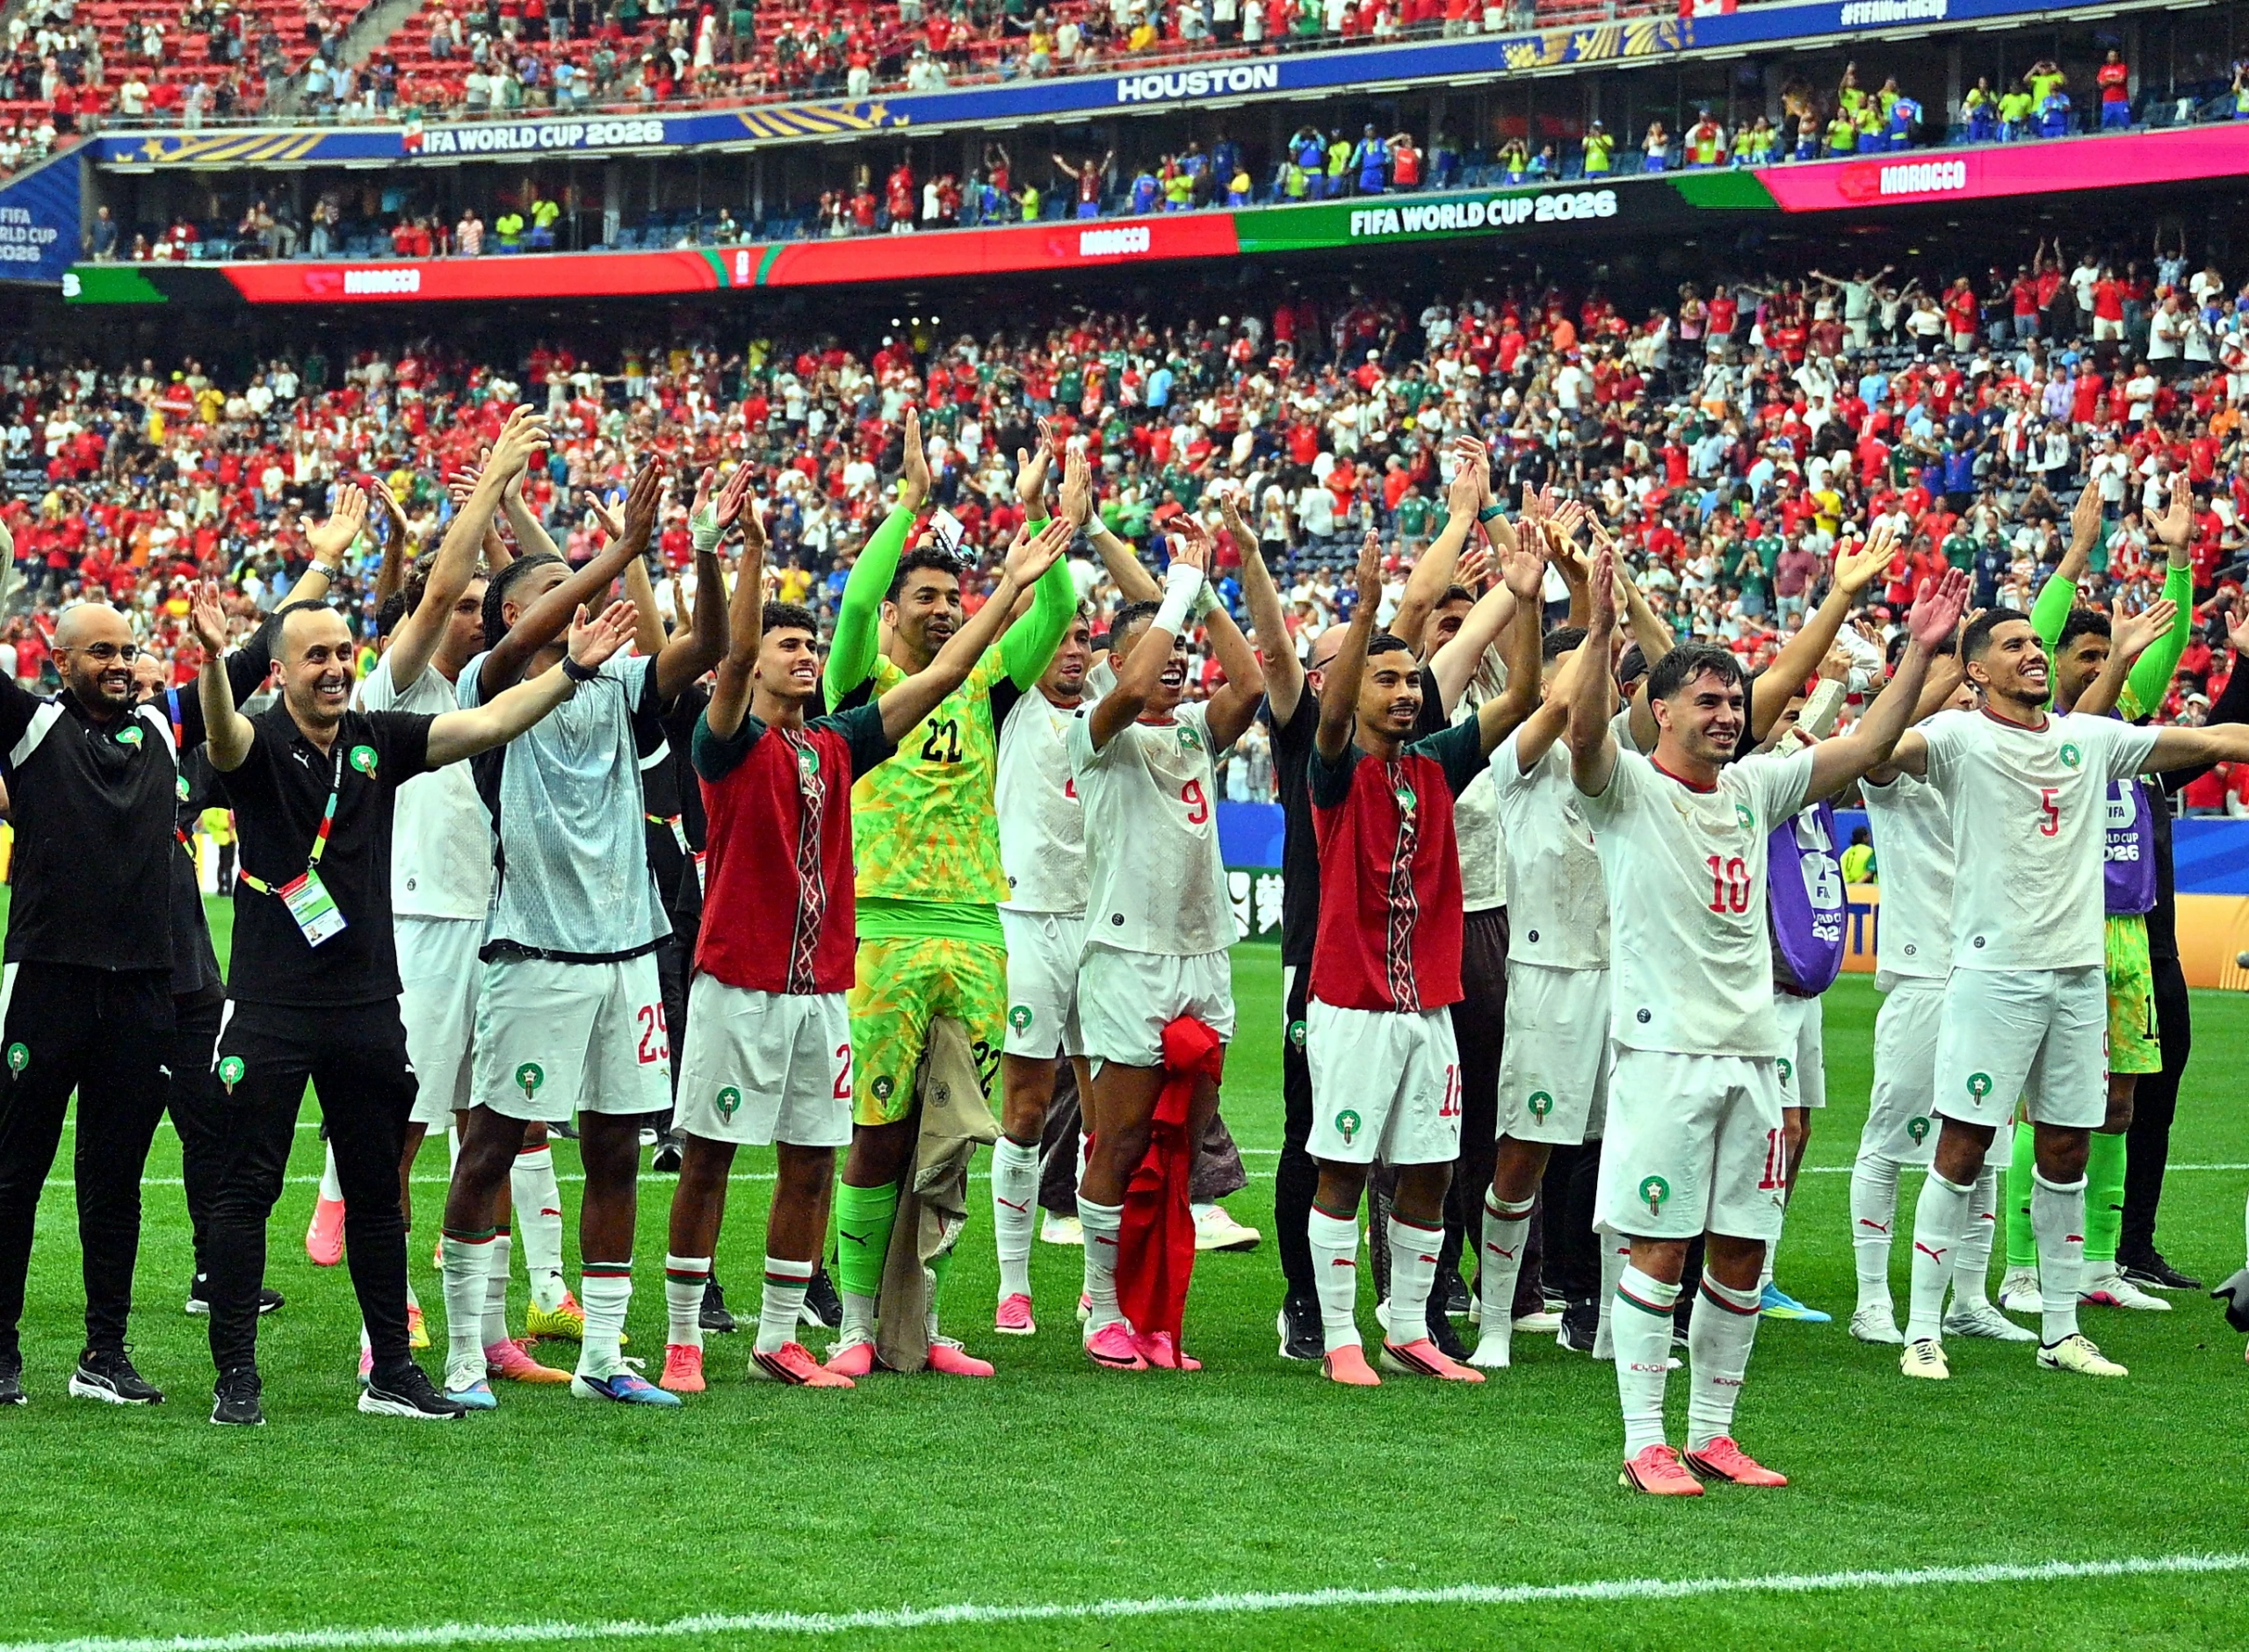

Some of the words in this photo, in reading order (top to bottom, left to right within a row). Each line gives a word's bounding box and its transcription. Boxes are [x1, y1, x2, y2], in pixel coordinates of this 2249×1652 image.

[1840, 0, 1948, 25] #FIFAWorldCup
[1117, 64, 1278, 102] HOUSTON
[410, 130, 456, 154] IFA
[458, 126, 537, 151] WORLD
[539, 125, 583, 148] CUP
[585, 120, 664, 145] 2026
[1880, 160, 1966, 195] MOROCCO
[0, 206, 32, 224] FIFA
[1350, 208, 1399, 236] FIFA
[1401, 201, 1485, 232] WORLD
[1486, 197, 1534, 225] CUP
[1535, 190, 1616, 221] 2026
[0, 226, 26, 243] RLD
[28, 227, 57, 243] CUP
[1080, 227, 1150, 256] MOROCCO
[0, 244, 41, 262] 026
[343, 269, 420, 293] MOROCCO
[921, 718, 963, 763] 22
[1181, 778, 1210, 825] 9
[2040, 789, 2059, 836] 5
[2107, 806, 2125, 818] IFA
[2121, 833, 2139, 843] CUP
[2103, 844, 2140, 862] 026
[1706, 855, 1751, 913] 10
